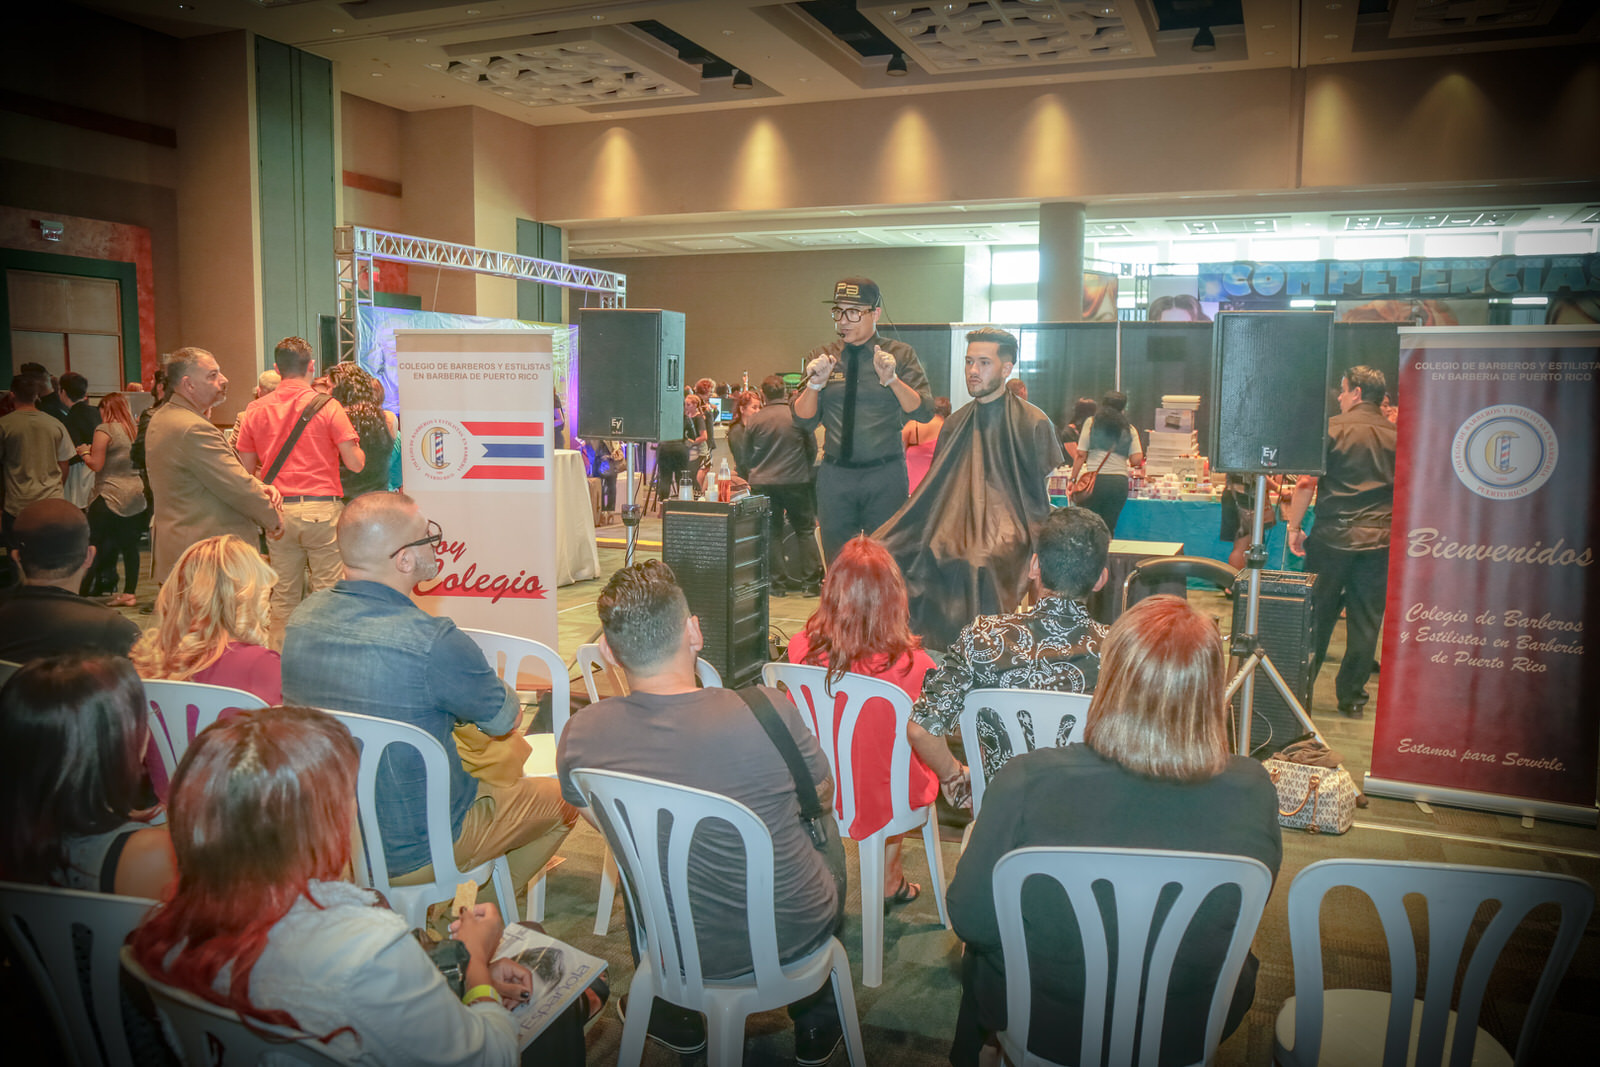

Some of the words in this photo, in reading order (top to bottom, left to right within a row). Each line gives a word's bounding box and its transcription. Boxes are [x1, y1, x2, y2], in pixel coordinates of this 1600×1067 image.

[399, 362, 435, 370] COLEGIO
[437, 362, 449, 370] DE
[450, 362, 496, 370] BARBEROS
[497, 362, 504, 370] Y
[505, 362, 551, 370] ESTILISTAS
[413, 372, 425, 380] EN
[470, 372, 481, 380] DE
[483, 372, 517, 380] PUERTO
[1414, 362, 1460, 370] COLEGIO
[1462, 362, 1475, 370] DE
[1478, 362, 1536, 370] BARBEROS
[1538, 362, 1546, 370] Y
[1431, 373, 1446, 381] EN
[1502, 373, 1517, 381] DE
[1519, 373, 1562, 381] PUERTO
[1565, 373, 1592, 381] RICO
[435, 540, 467, 563] oy
[1406, 527, 1594, 567] Bienvenidos
[1405, 602, 1468, 626] Colegio
[1475, 610, 1497, 625] de
[1503, 610, 1584, 632] Barberos
[1400, 630, 1410, 643] y
[1415, 626, 1487, 646] Estilistas
[1493, 637, 1510, 648] en
[1430, 650, 1448, 664] de
[1453, 651, 1504, 669] Puerto
[1511, 656, 1547, 673] Rico
[1397, 738, 1457, 758] Estamos
[1461, 748, 1497, 763] para
[1502, 752, 1566, 772] Servirle.
